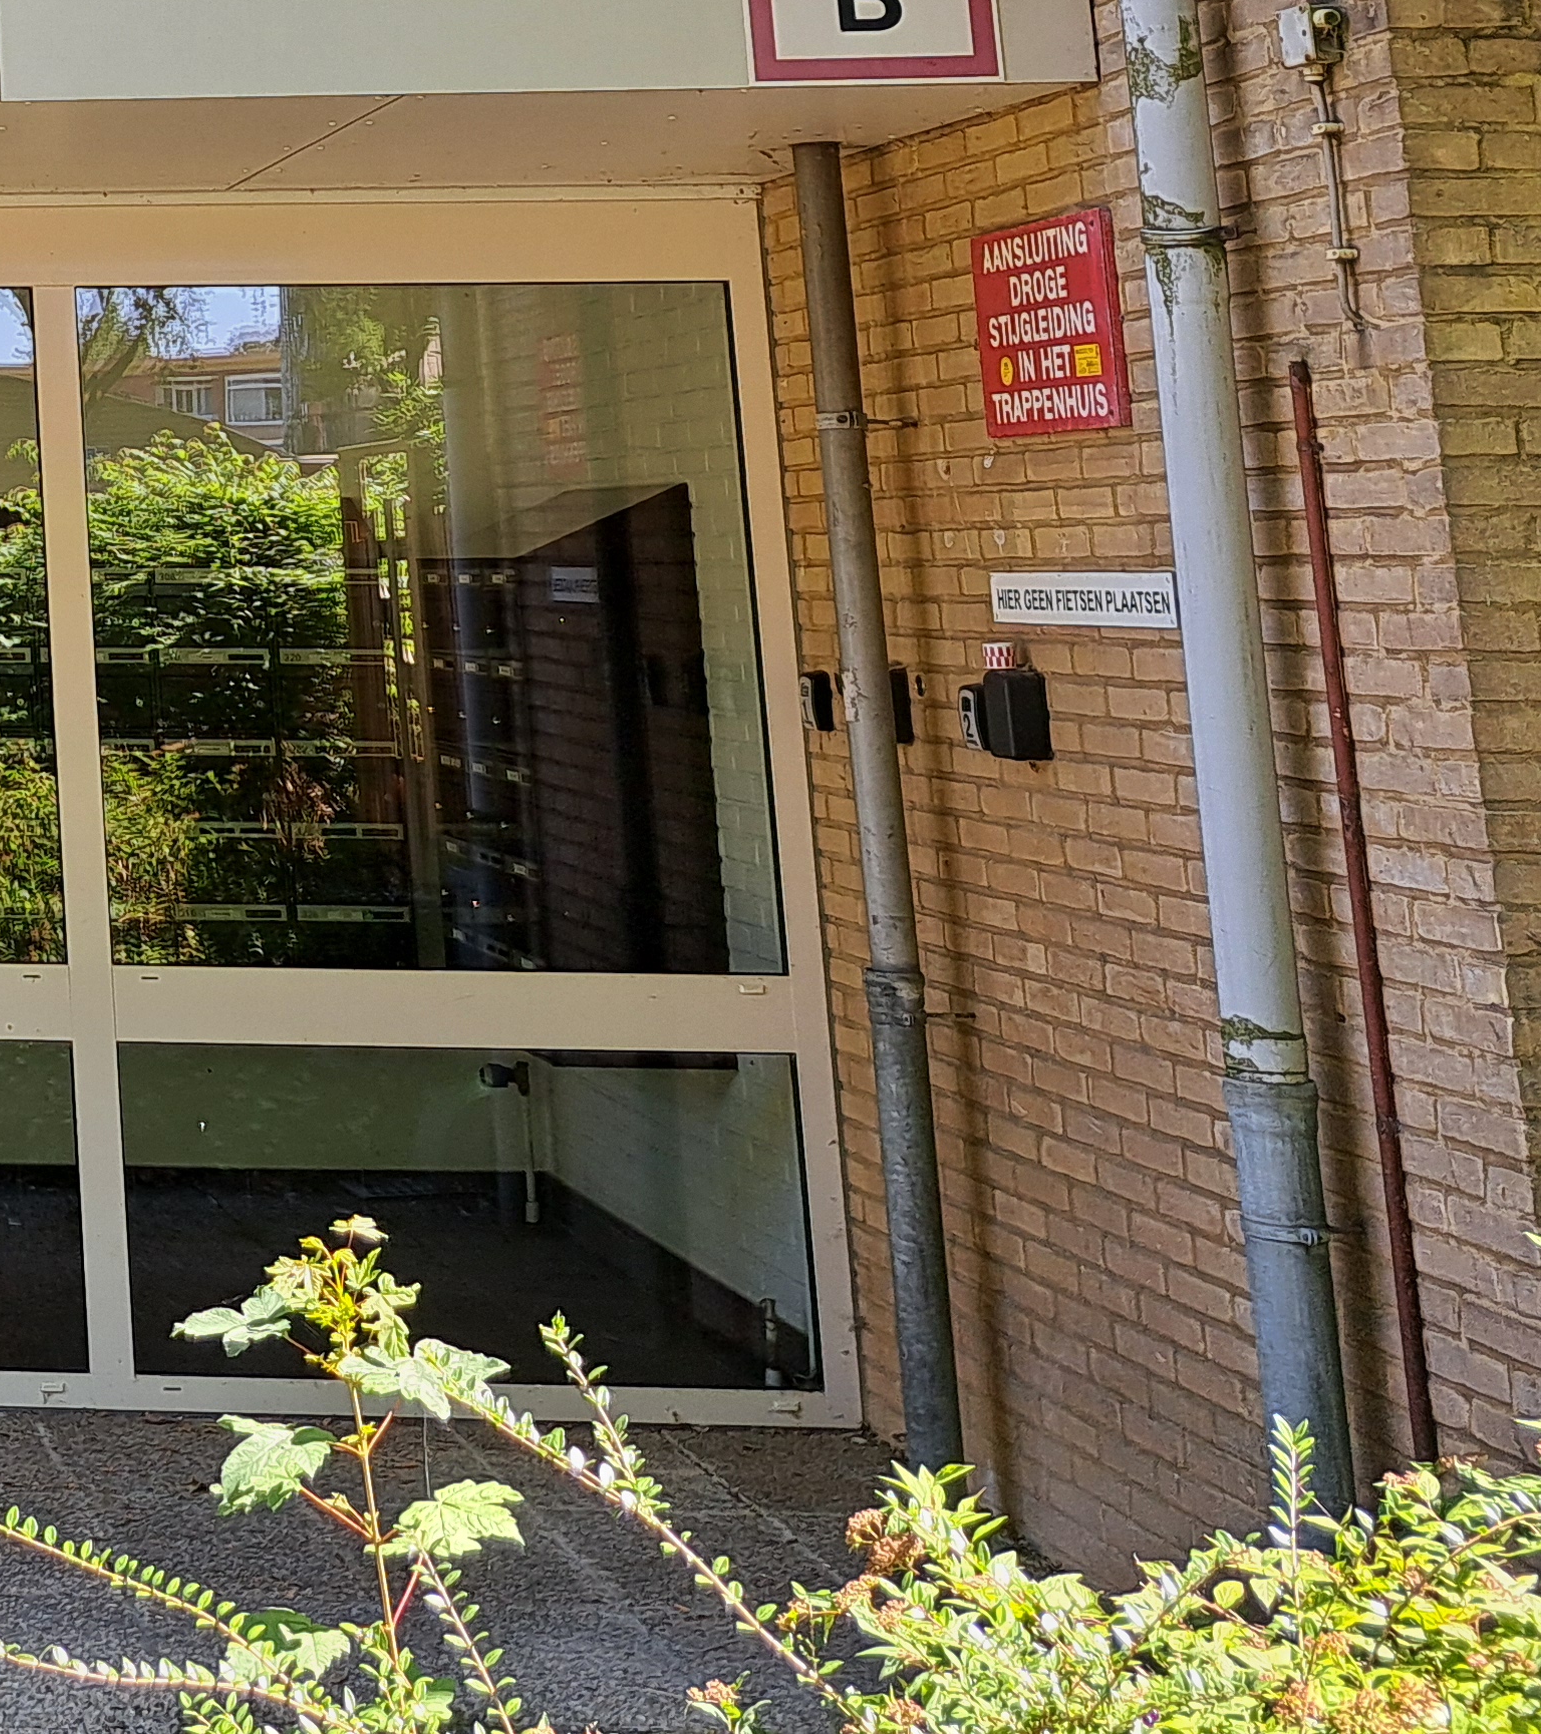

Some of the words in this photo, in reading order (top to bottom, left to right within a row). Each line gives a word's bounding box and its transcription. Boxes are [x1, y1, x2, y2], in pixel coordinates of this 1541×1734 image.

[981, 219, 1089, 275] AANSLUITING
[1008, 264, 1069, 307] DROGE
[988, 299, 1096, 349] STIJGLEIDING
[1017, 349, 1036, 383] IN
[1039, 344, 1072, 381] HET
[991, 383, 1109, 425] TRAPPENHUIS
[996, 587, 1023, 611] HIER
[1024, 588, 1054, 612] GEEN
[1056, 588, 1103, 614] FIETSEN
[1105, 589, 1171, 616] PLAATSEN
